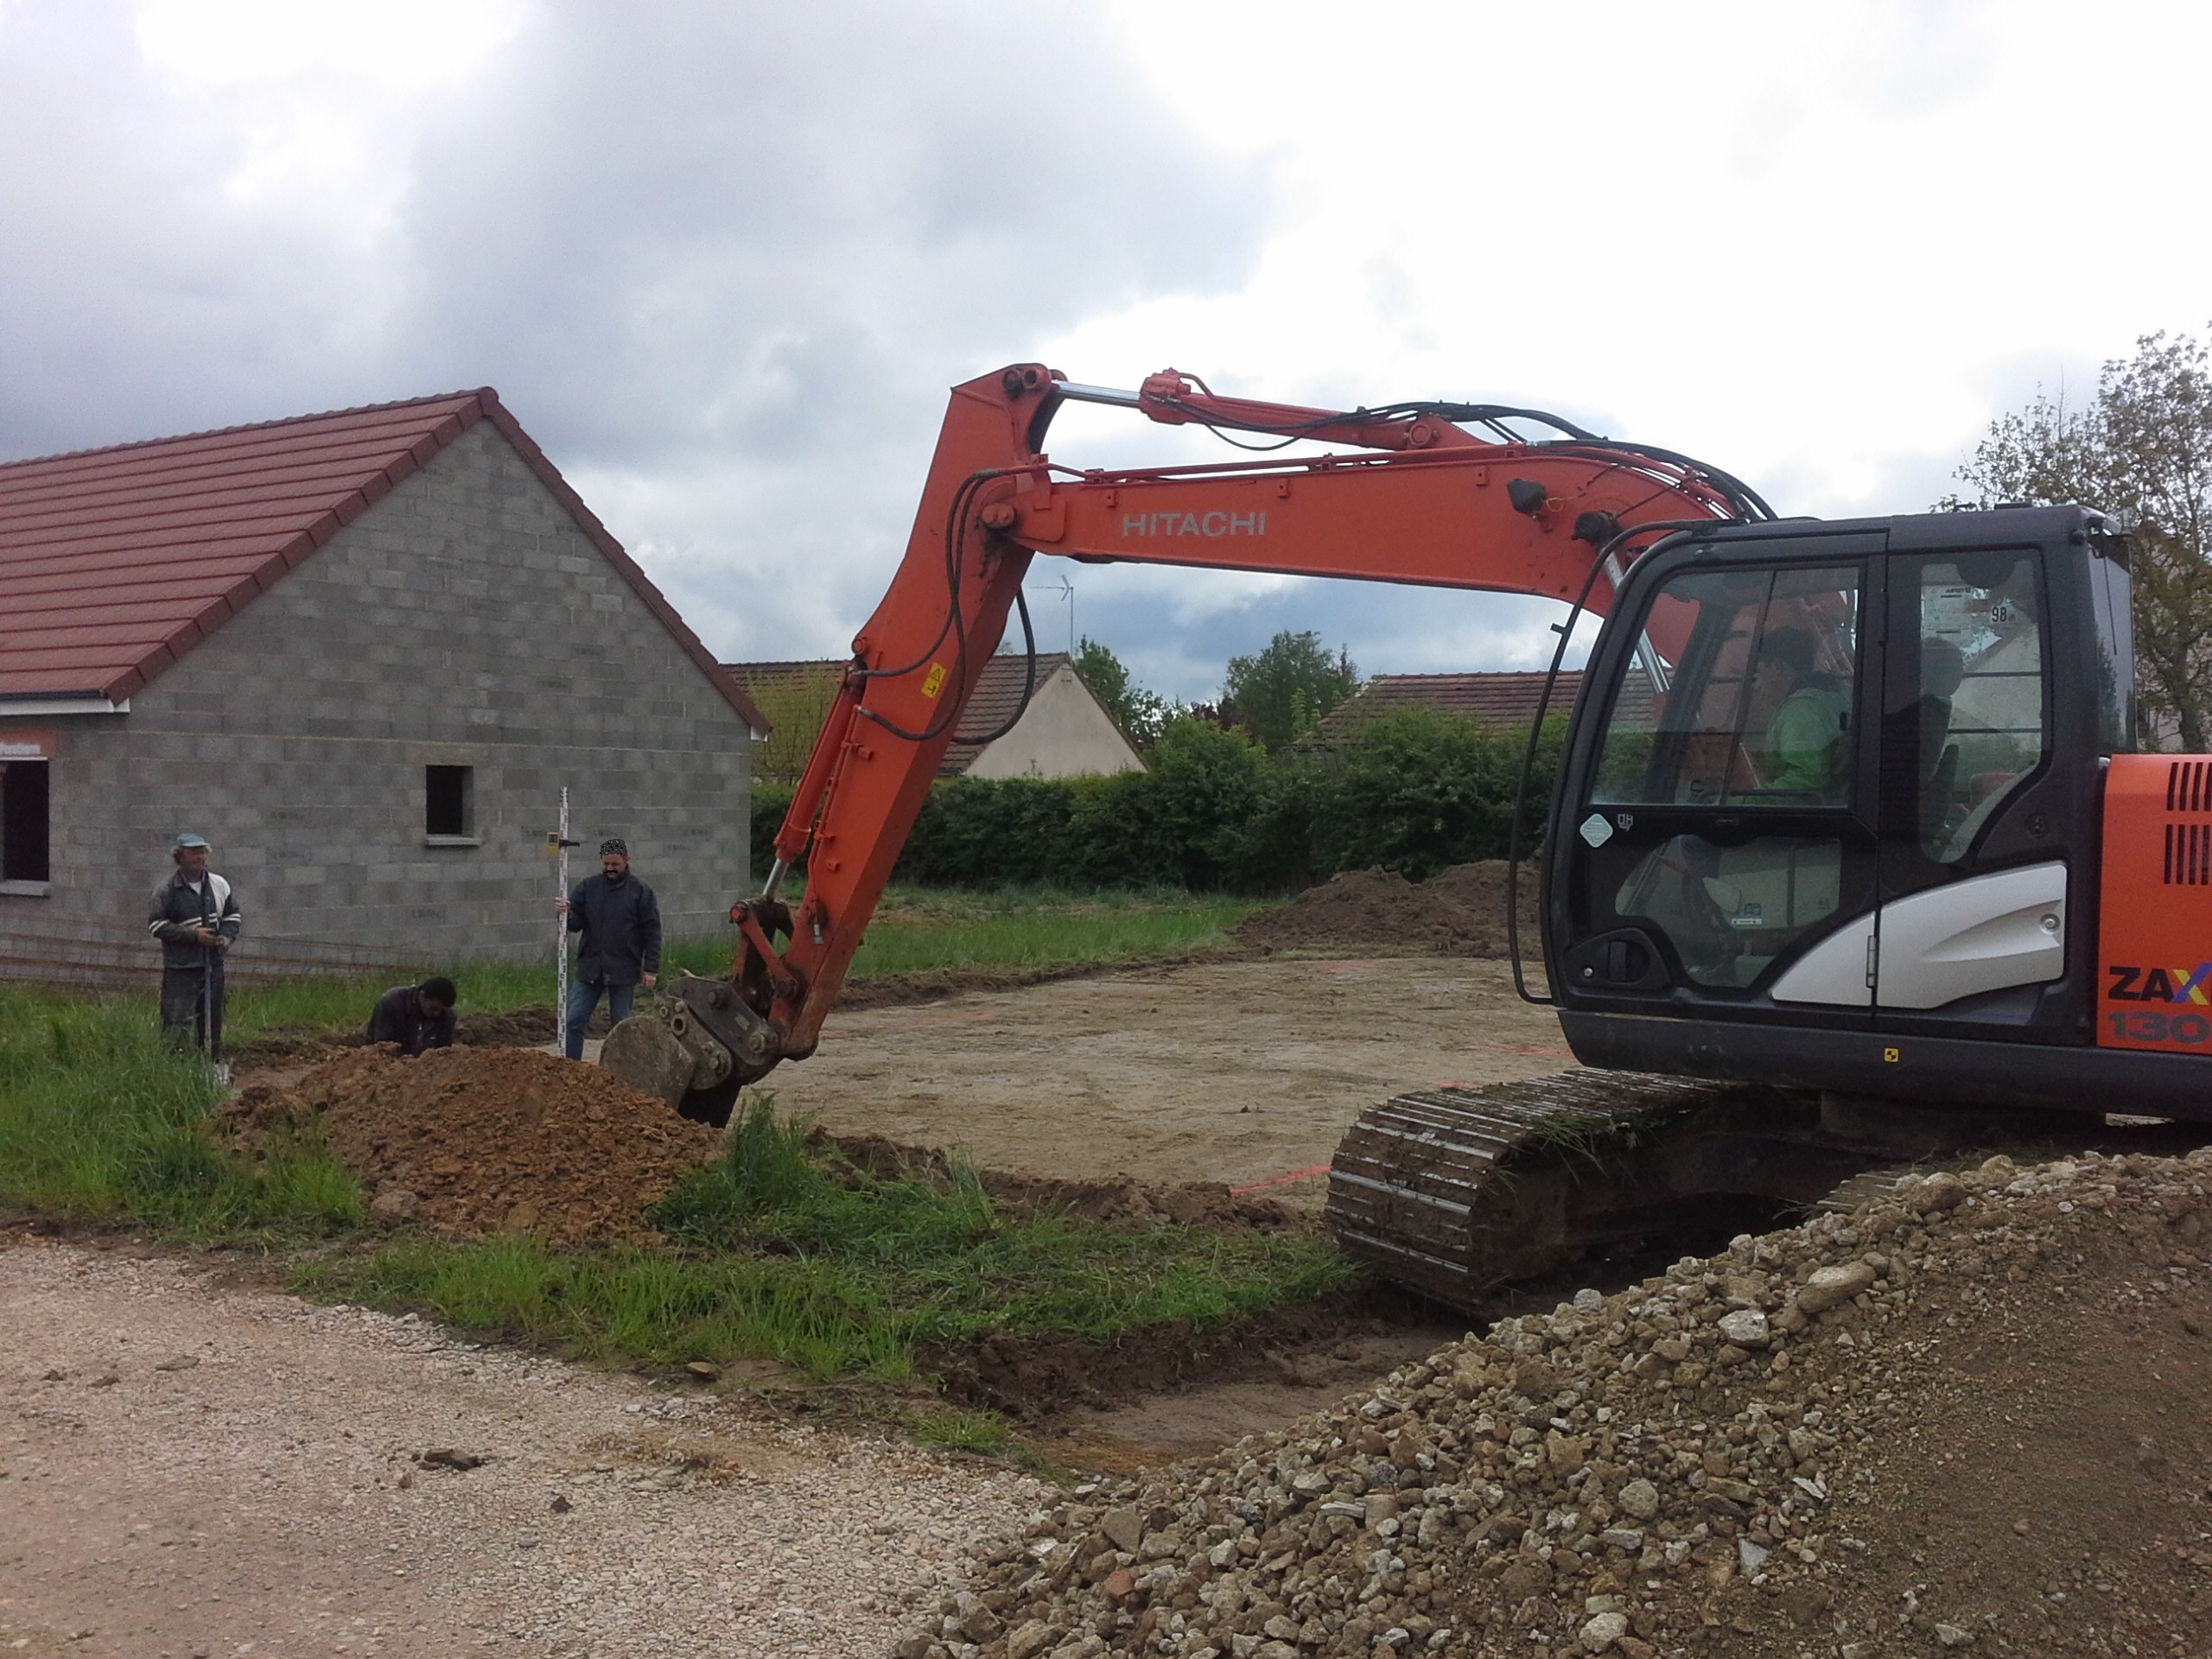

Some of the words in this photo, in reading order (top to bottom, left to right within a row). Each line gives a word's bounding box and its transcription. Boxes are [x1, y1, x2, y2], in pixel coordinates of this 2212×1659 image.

[1122, 512, 1267, 537] HITACHI
[1991, 606, 2007, 623] 98
[2108, 962, 2212, 1006] ZAX
[2108, 1011, 2211, 1044] 130
